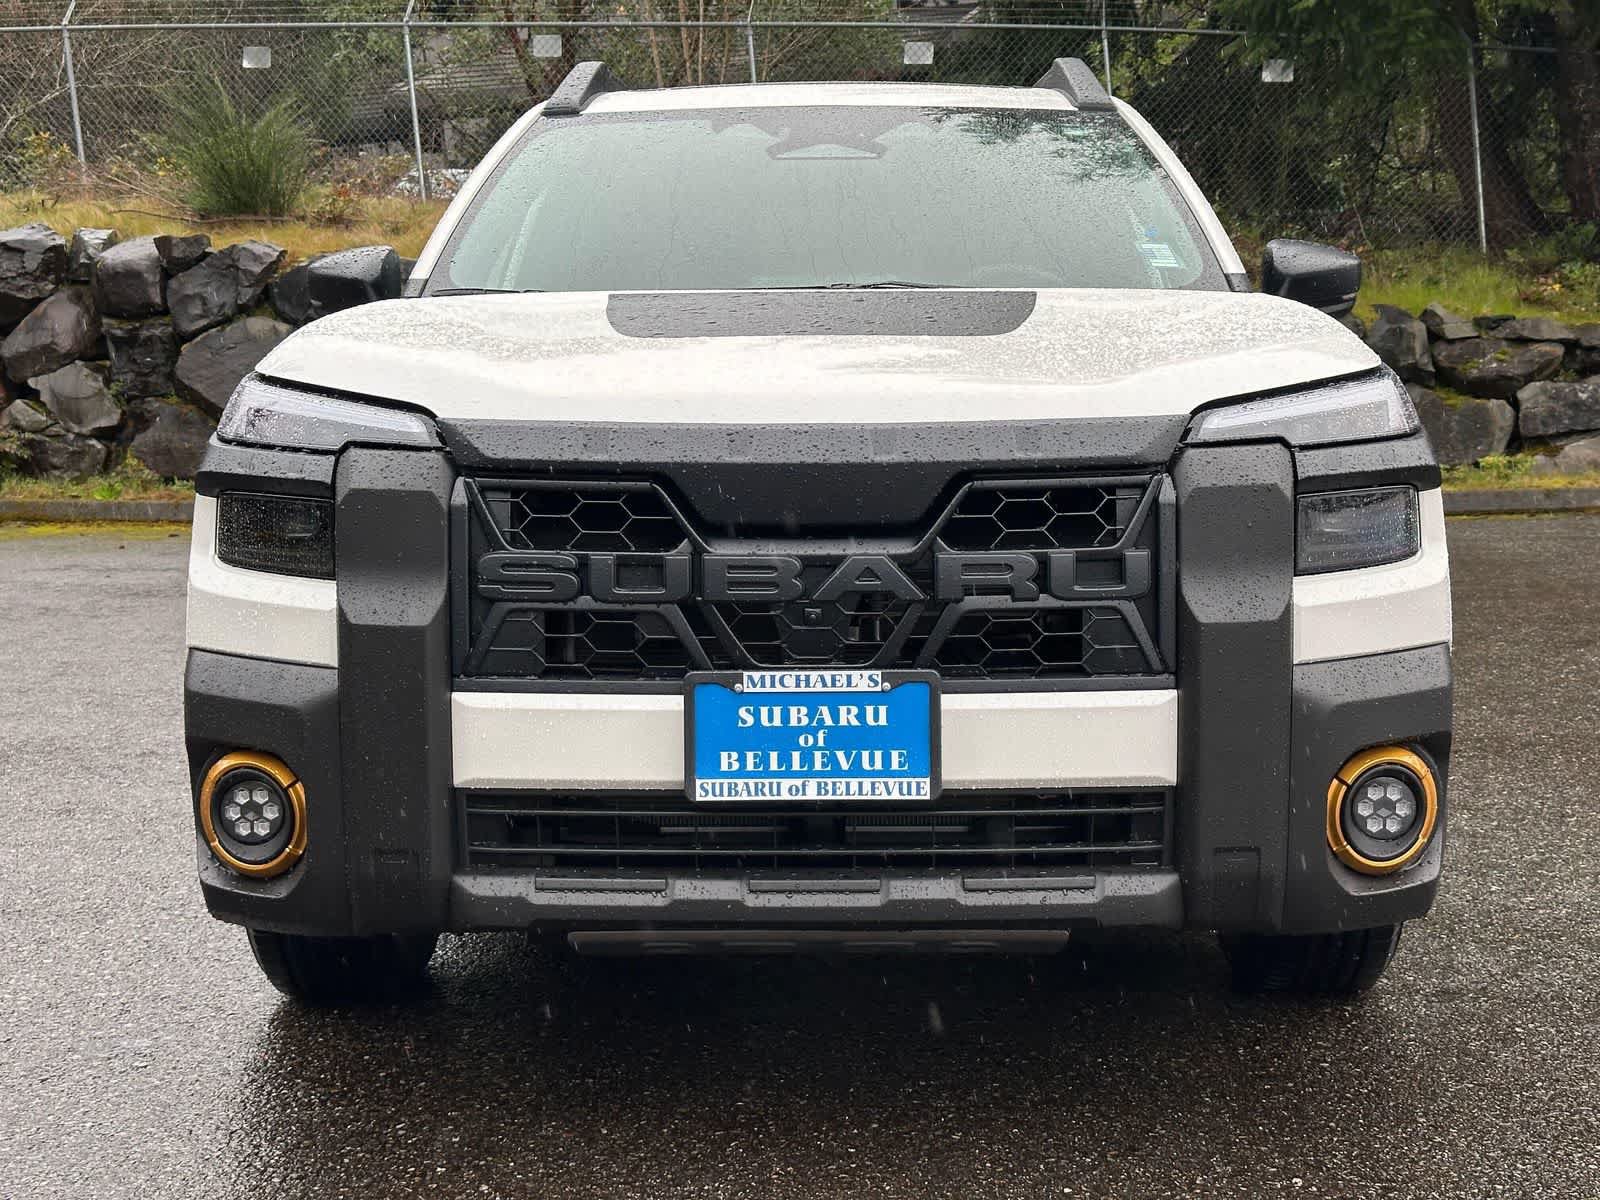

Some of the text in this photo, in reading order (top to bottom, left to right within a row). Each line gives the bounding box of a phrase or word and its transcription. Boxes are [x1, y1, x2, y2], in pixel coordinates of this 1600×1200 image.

[476, 550, 1150, 602] SUBARU
[745, 673, 881, 689] MICHAEL'S
[737, 704, 889, 728] SUBARU
[797, 729, 828, 748] of
[719, 749, 910, 772] BELLEVUE
[699, 780, 928, 798] SUBARU of BELLEVUE
